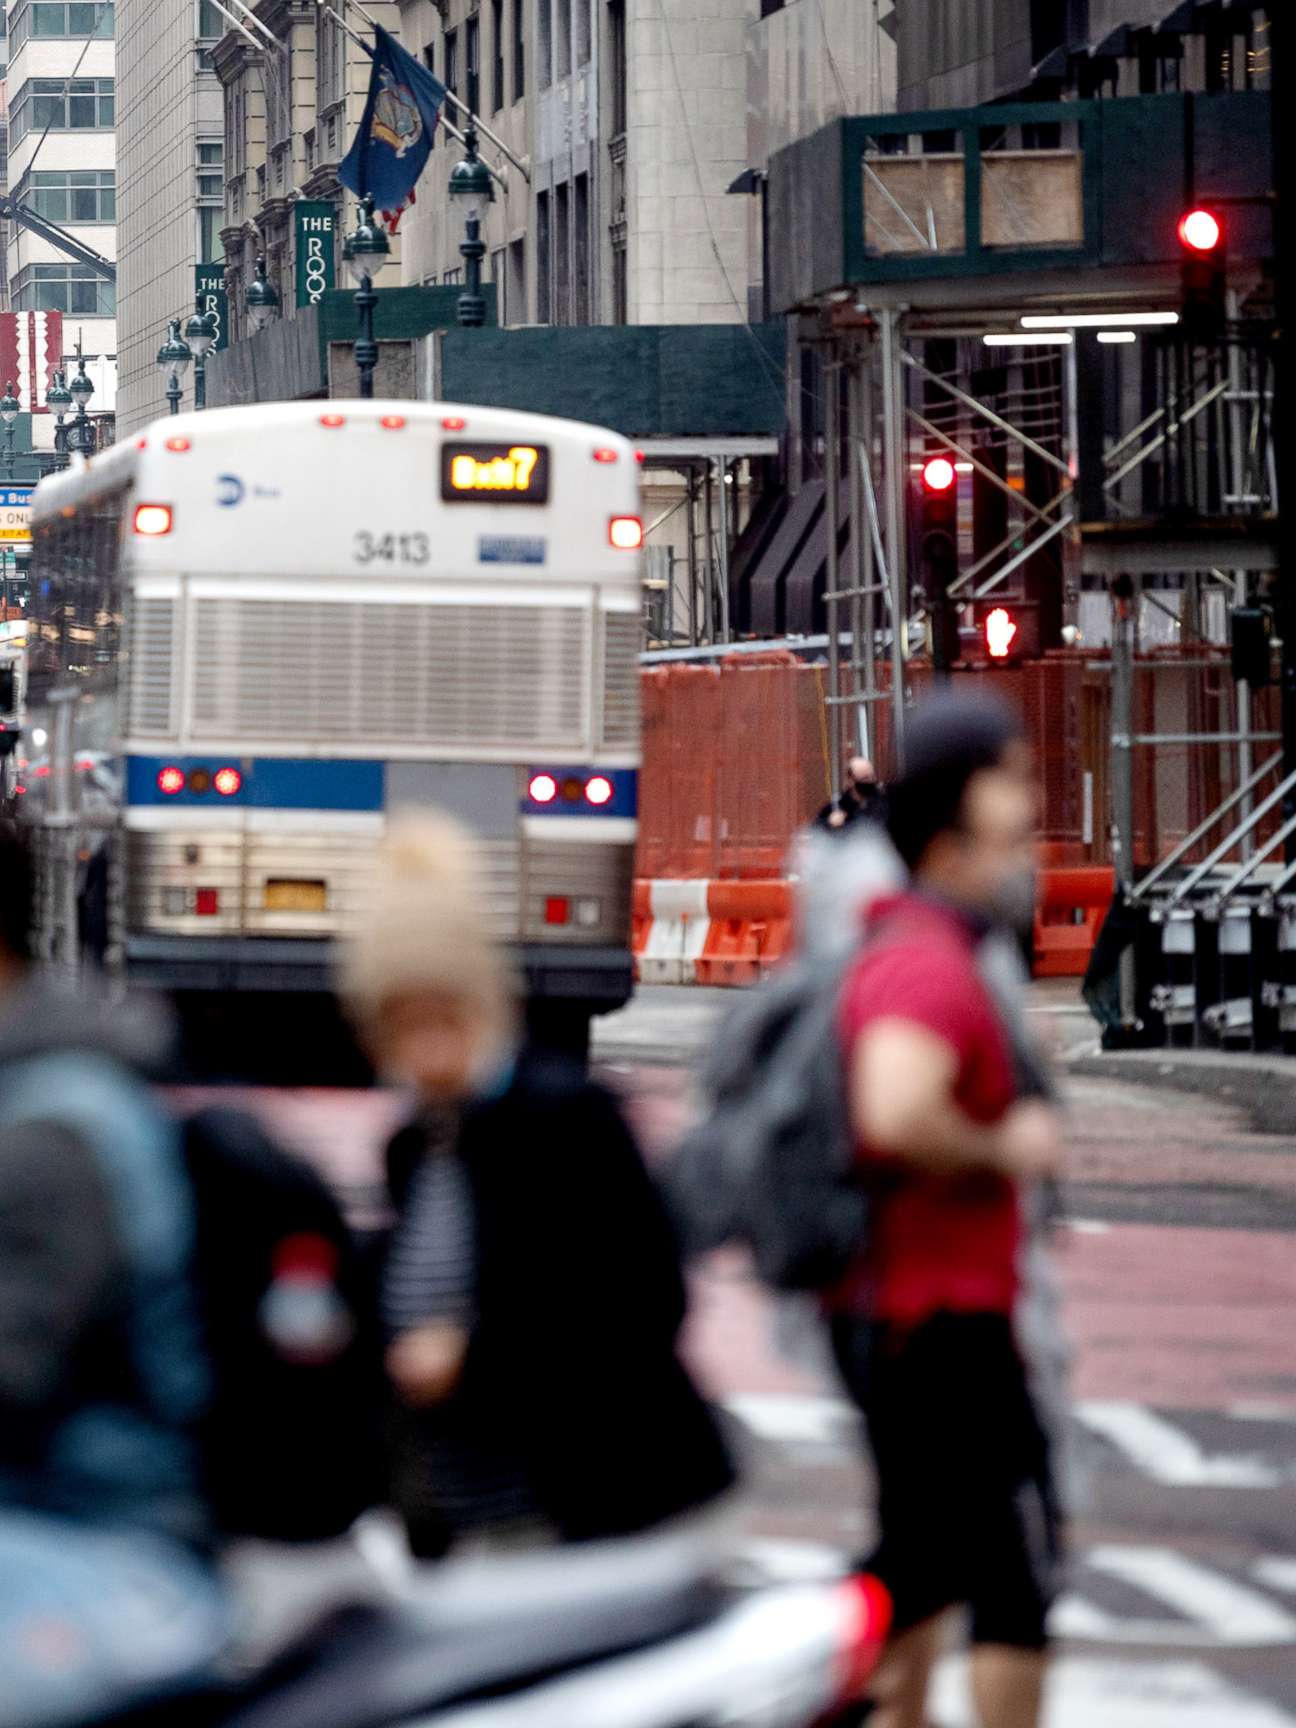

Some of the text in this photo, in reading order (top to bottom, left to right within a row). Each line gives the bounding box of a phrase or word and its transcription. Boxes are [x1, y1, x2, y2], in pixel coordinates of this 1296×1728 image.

[301, 217, 332, 231] THE
[200, 278, 225, 290] THE
[7, 513, 32, 524] ONL
[354, 531, 430, 564] 3413
